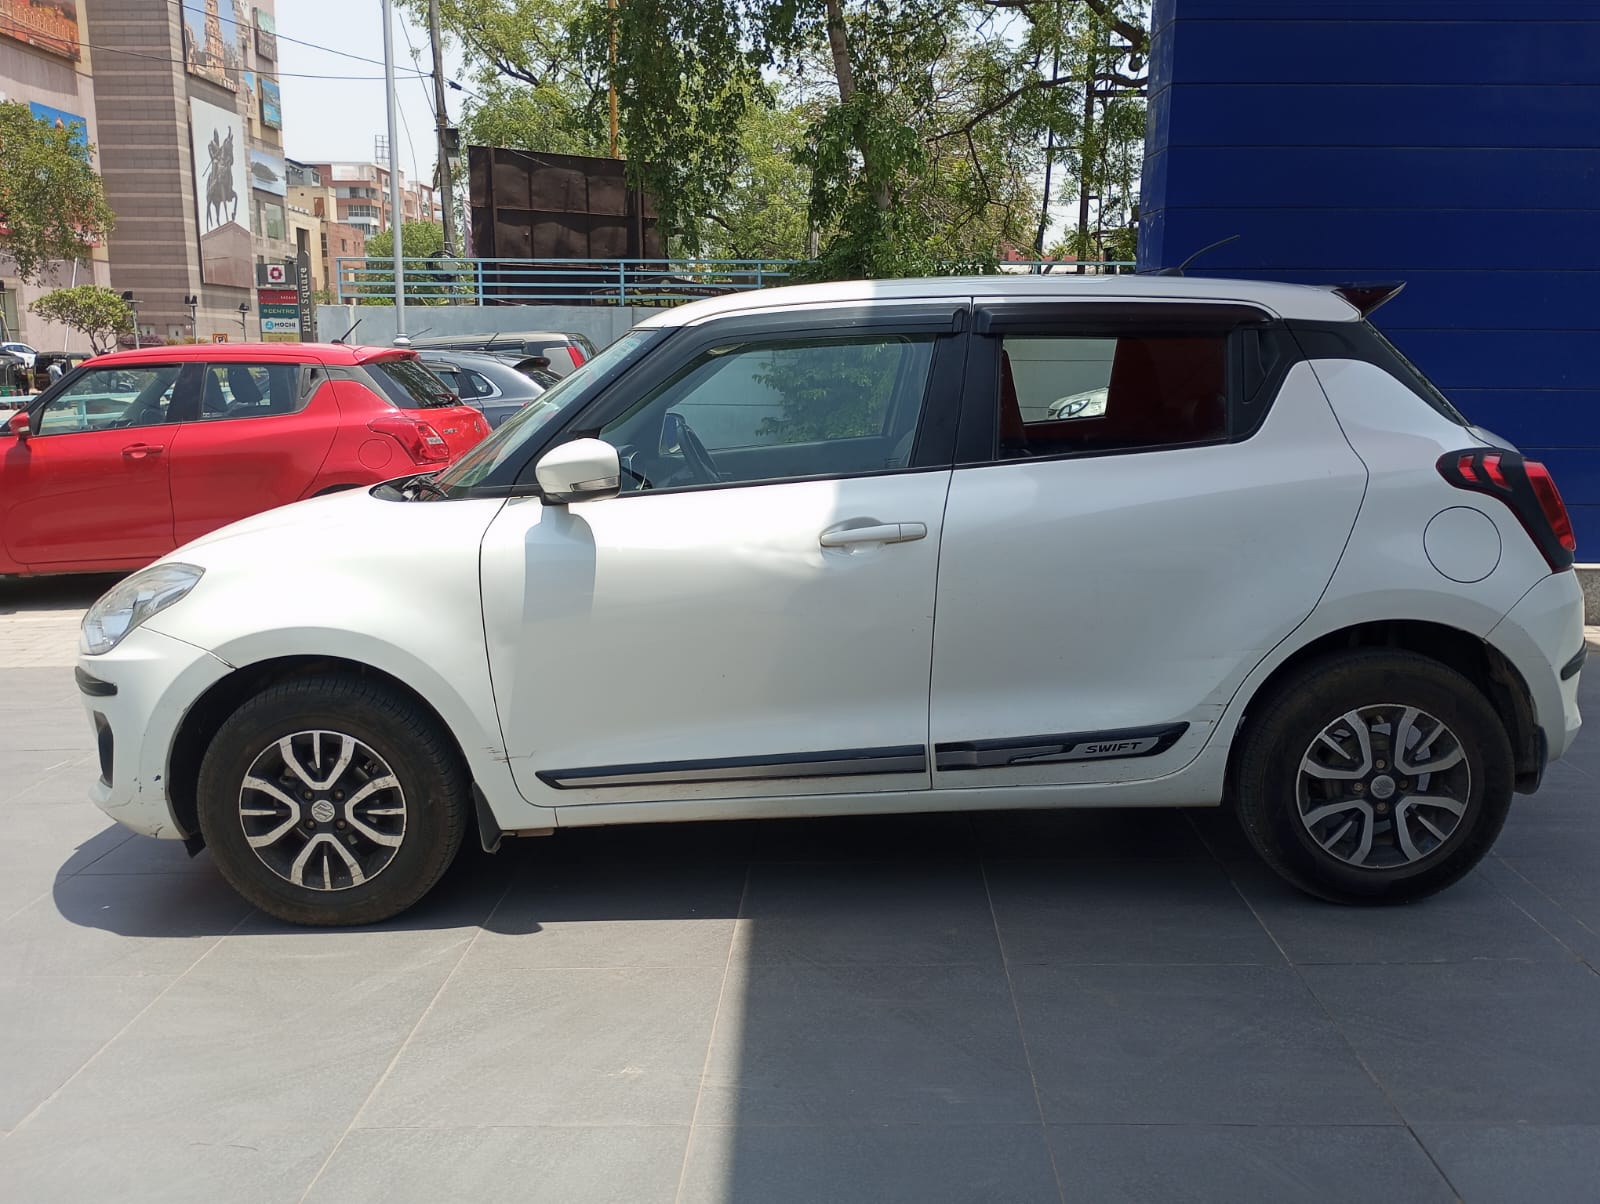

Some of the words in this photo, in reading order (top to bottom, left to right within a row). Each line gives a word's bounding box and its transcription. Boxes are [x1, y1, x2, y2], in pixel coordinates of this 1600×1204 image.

[300, 267, 310, 305] Square
[302, 308, 311, 332] Pink
[1084, 742, 1142, 754] SWIFT
